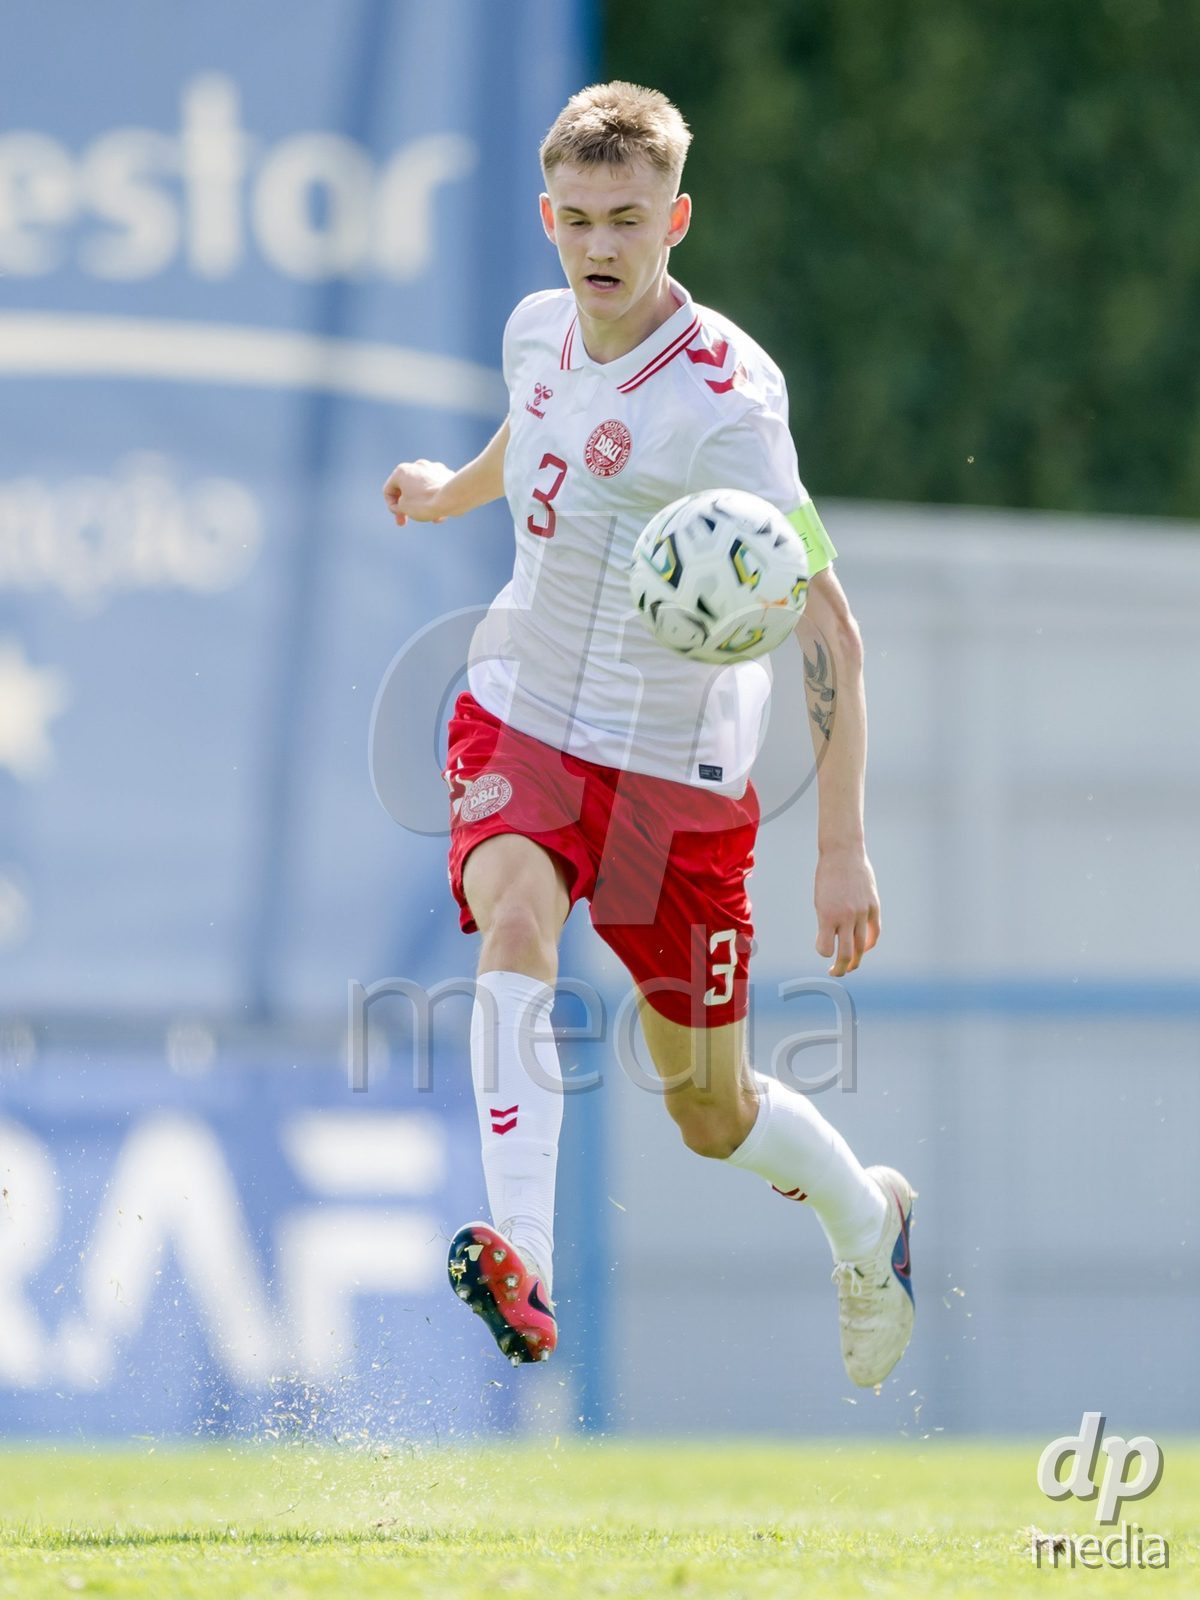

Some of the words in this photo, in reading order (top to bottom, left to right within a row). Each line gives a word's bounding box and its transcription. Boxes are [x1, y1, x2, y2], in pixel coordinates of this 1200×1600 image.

[594, 433, 622, 462] DBU
[527, 453, 568, 539] 3
[469, 785, 500, 810] DBU
[703, 928, 739, 1007] 3
